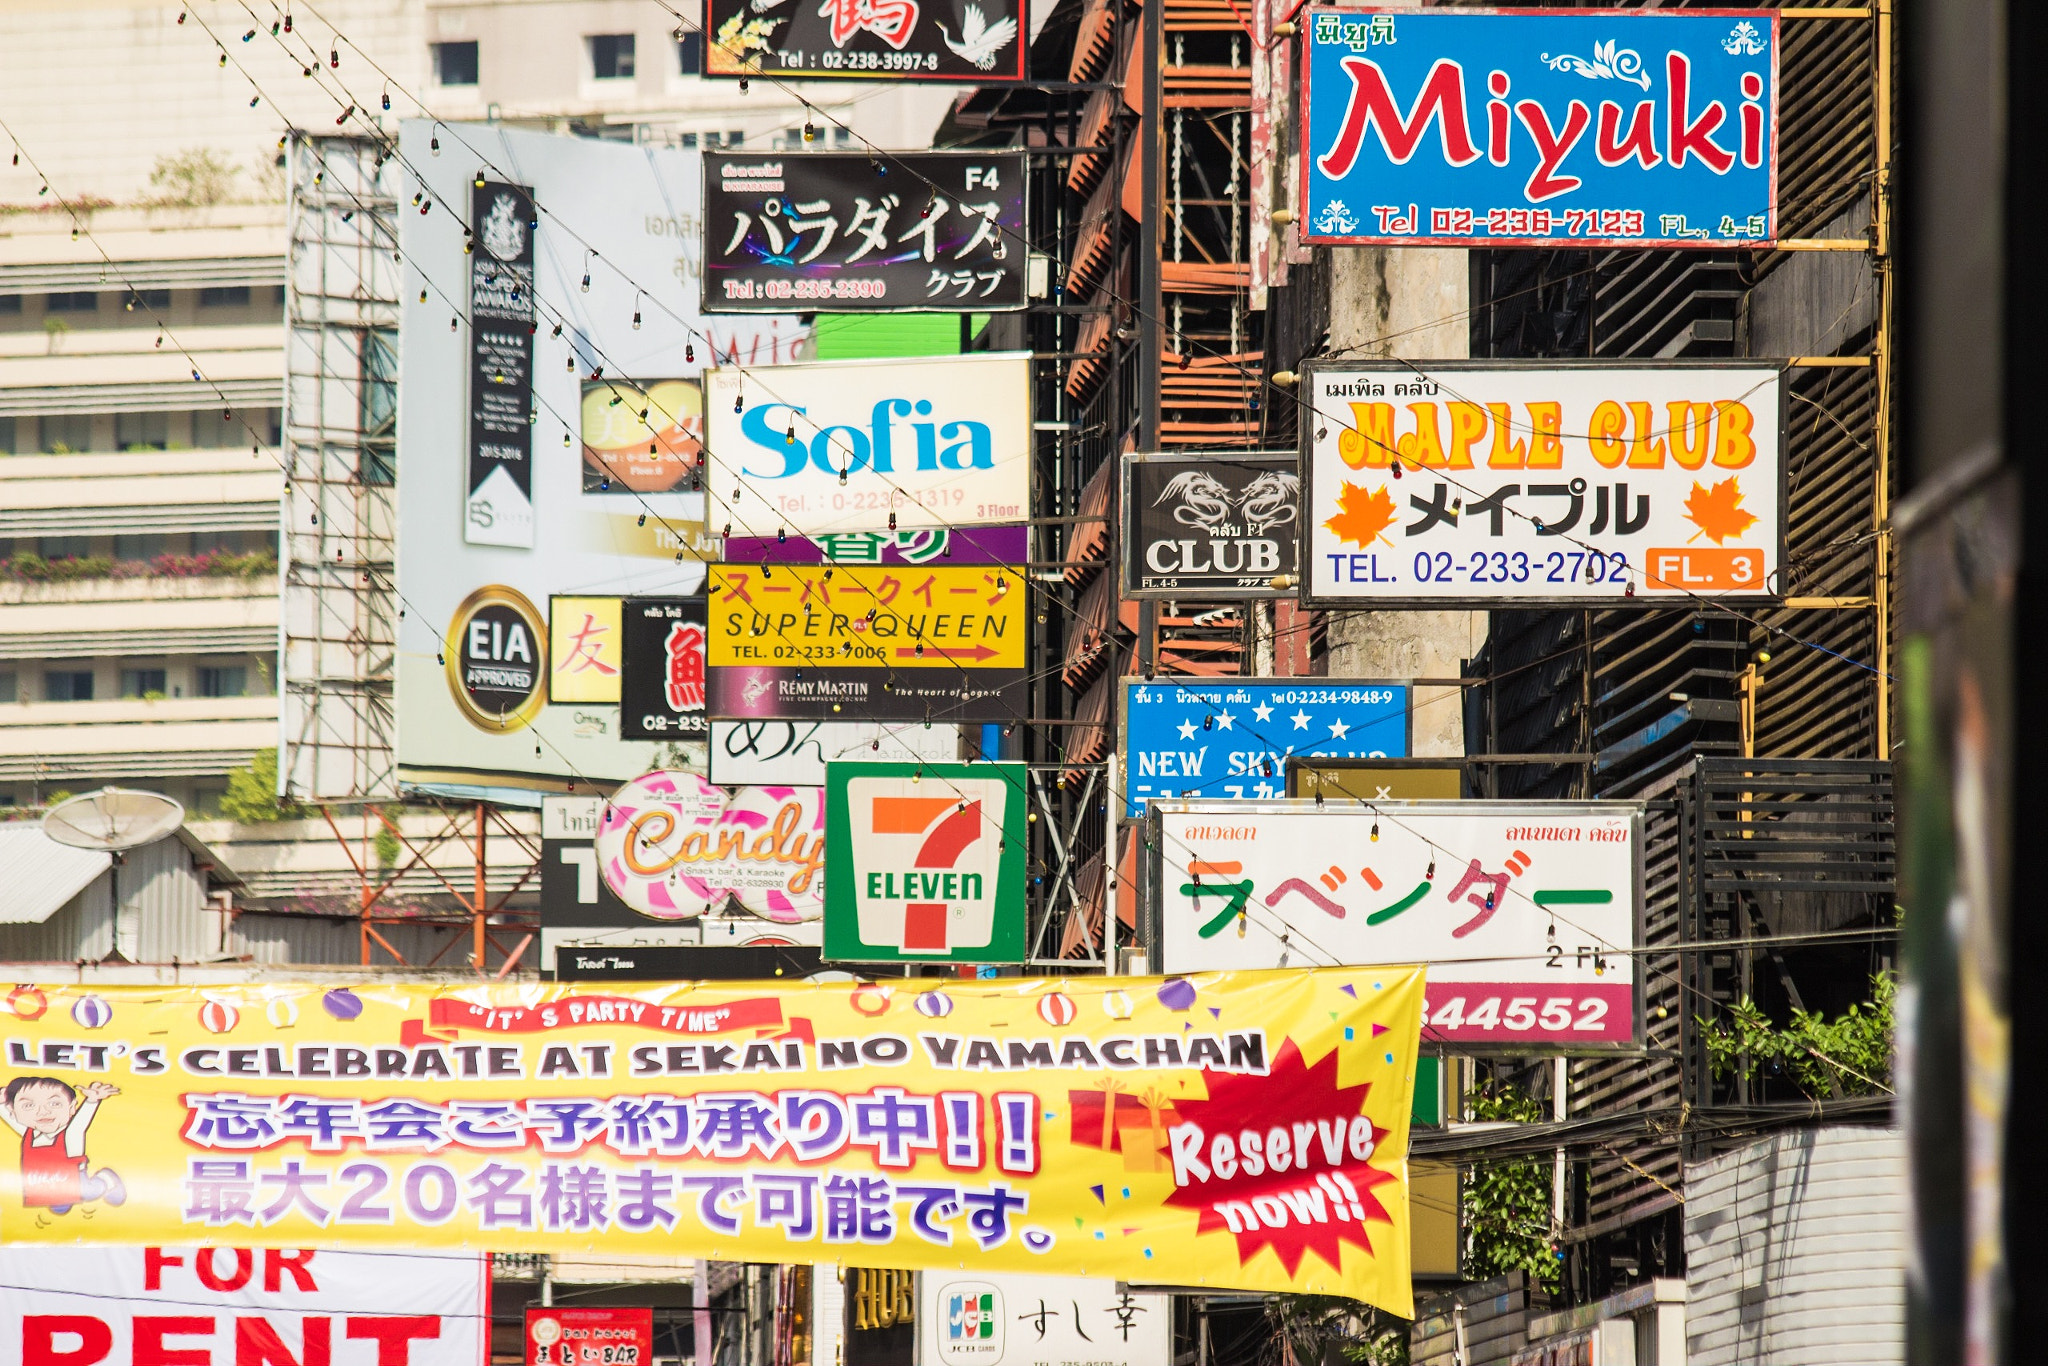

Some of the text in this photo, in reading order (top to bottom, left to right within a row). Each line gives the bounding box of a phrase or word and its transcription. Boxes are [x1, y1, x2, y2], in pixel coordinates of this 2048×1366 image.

[778, 51, 803, 68] Tel
[822, 52, 938, 70] 02-238-3997-8
[1316, 50, 1765, 203] Miyuki
[966, 168, 1000, 191] F4
[724, 194, 1008, 265] パラダイス
[1372, 204, 1419, 234] Tel
[1430, 208, 1644, 236] 02-236-7123
[1717, 215, 1766, 238] 4-5
[765, 280, 886, 299] 02-235-2390
[926, 268, 1007, 299] クラブ
[1394, 377, 1440, 397] คลับ
[740, 398, 995, 479] Sofia
[1338, 400, 1757, 470] MAPLE CLUB
[778, 494, 811, 513] Tel.
[977, 503, 1019, 518] 3 Floor
[1405, 477, 1650, 538] メイプル
[1209, 523, 1241, 536] คลับ
[1146, 539, 1280, 574] CLUB
[1327, 553, 1397, 583] TEL.
[1413, 551, 1627, 584] 02-233-2702
[1658, 556, 1714, 582] FL.
[1730, 556, 1753, 582] 3
[726, 613, 848, 637] SUPER
[872, 614, 1008, 638] QUEEN
[469, 621, 531, 664] EIA
[556, 614, 620, 676] 友
[732, 646, 887, 659] TEL. 02-233-7006
[468, 668, 531, 688] APPROVED
[779, 679, 816, 695] RÉMY
[895, 688, 912, 696] The
[1157, 694, 1163, 703] 3
[1227, 689, 1251, 704] คลับ
[1272, 694, 1284, 703] Tel
[1286, 691, 1393, 704] 0-2234-9848-9
[1138, 745, 1295, 777] NEW SKY
[623, 802, 824, 894] Candy
[685, 866, 785, 878] Snack bar & Karaoke
[709, 878, 720, 886] Tel
[867, 872, 982, 900] ELEVEn
[872, 797, 981, 949] 7
[1179, 850, 1614, 939] ラベンダー
[1546, 945, 1563, 968] 2
[569, 1002, 646, 1023] PARTY
[8, 1033, 1268, 1078] LET'S CELEBRATE AT SEKAI NO YAMACHAN
[189, 1091, 1033, 1170] 忘年会ご予約承り中!!
[1169, 1115, 1376, 1186] Reserve
[1214, 1172, 1365, 1234] now!!
[145, 1249, 318, 1292] FOR
[1018, 1294, 1148, 1343] すし幸
[22, 1316, 441, 1366] RENT
[948, 1345, 975, 1353] JCB
